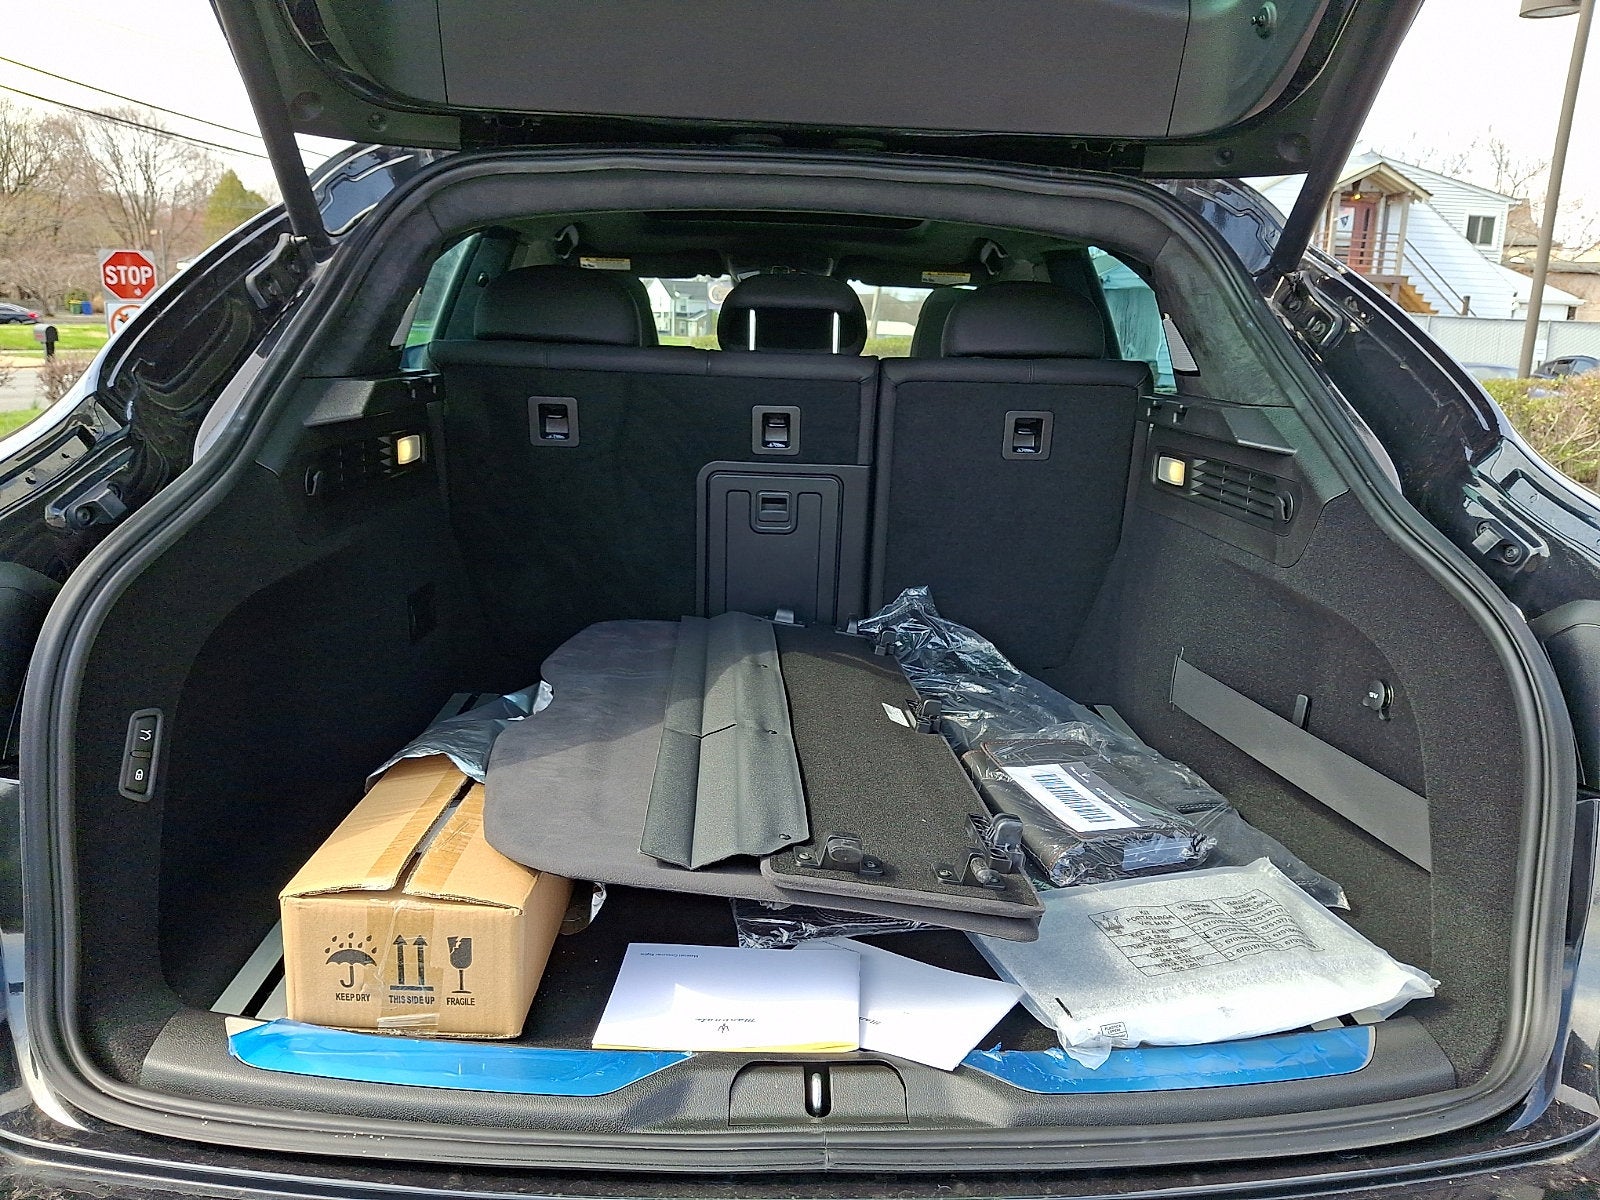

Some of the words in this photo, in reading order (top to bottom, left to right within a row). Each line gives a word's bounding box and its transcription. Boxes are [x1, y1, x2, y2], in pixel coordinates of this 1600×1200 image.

[105, 265, 153, 285] STOP
[335, 993, 355, 1001] KEEP
[355, 994, 370, 1002] DRY
[389, 995, 405, 1004] THIS
[408, 996, 424, 1004] SIDE
[425, 996, 435, 1005] UP
[446, 997, 475, 1006] FRAGILE
